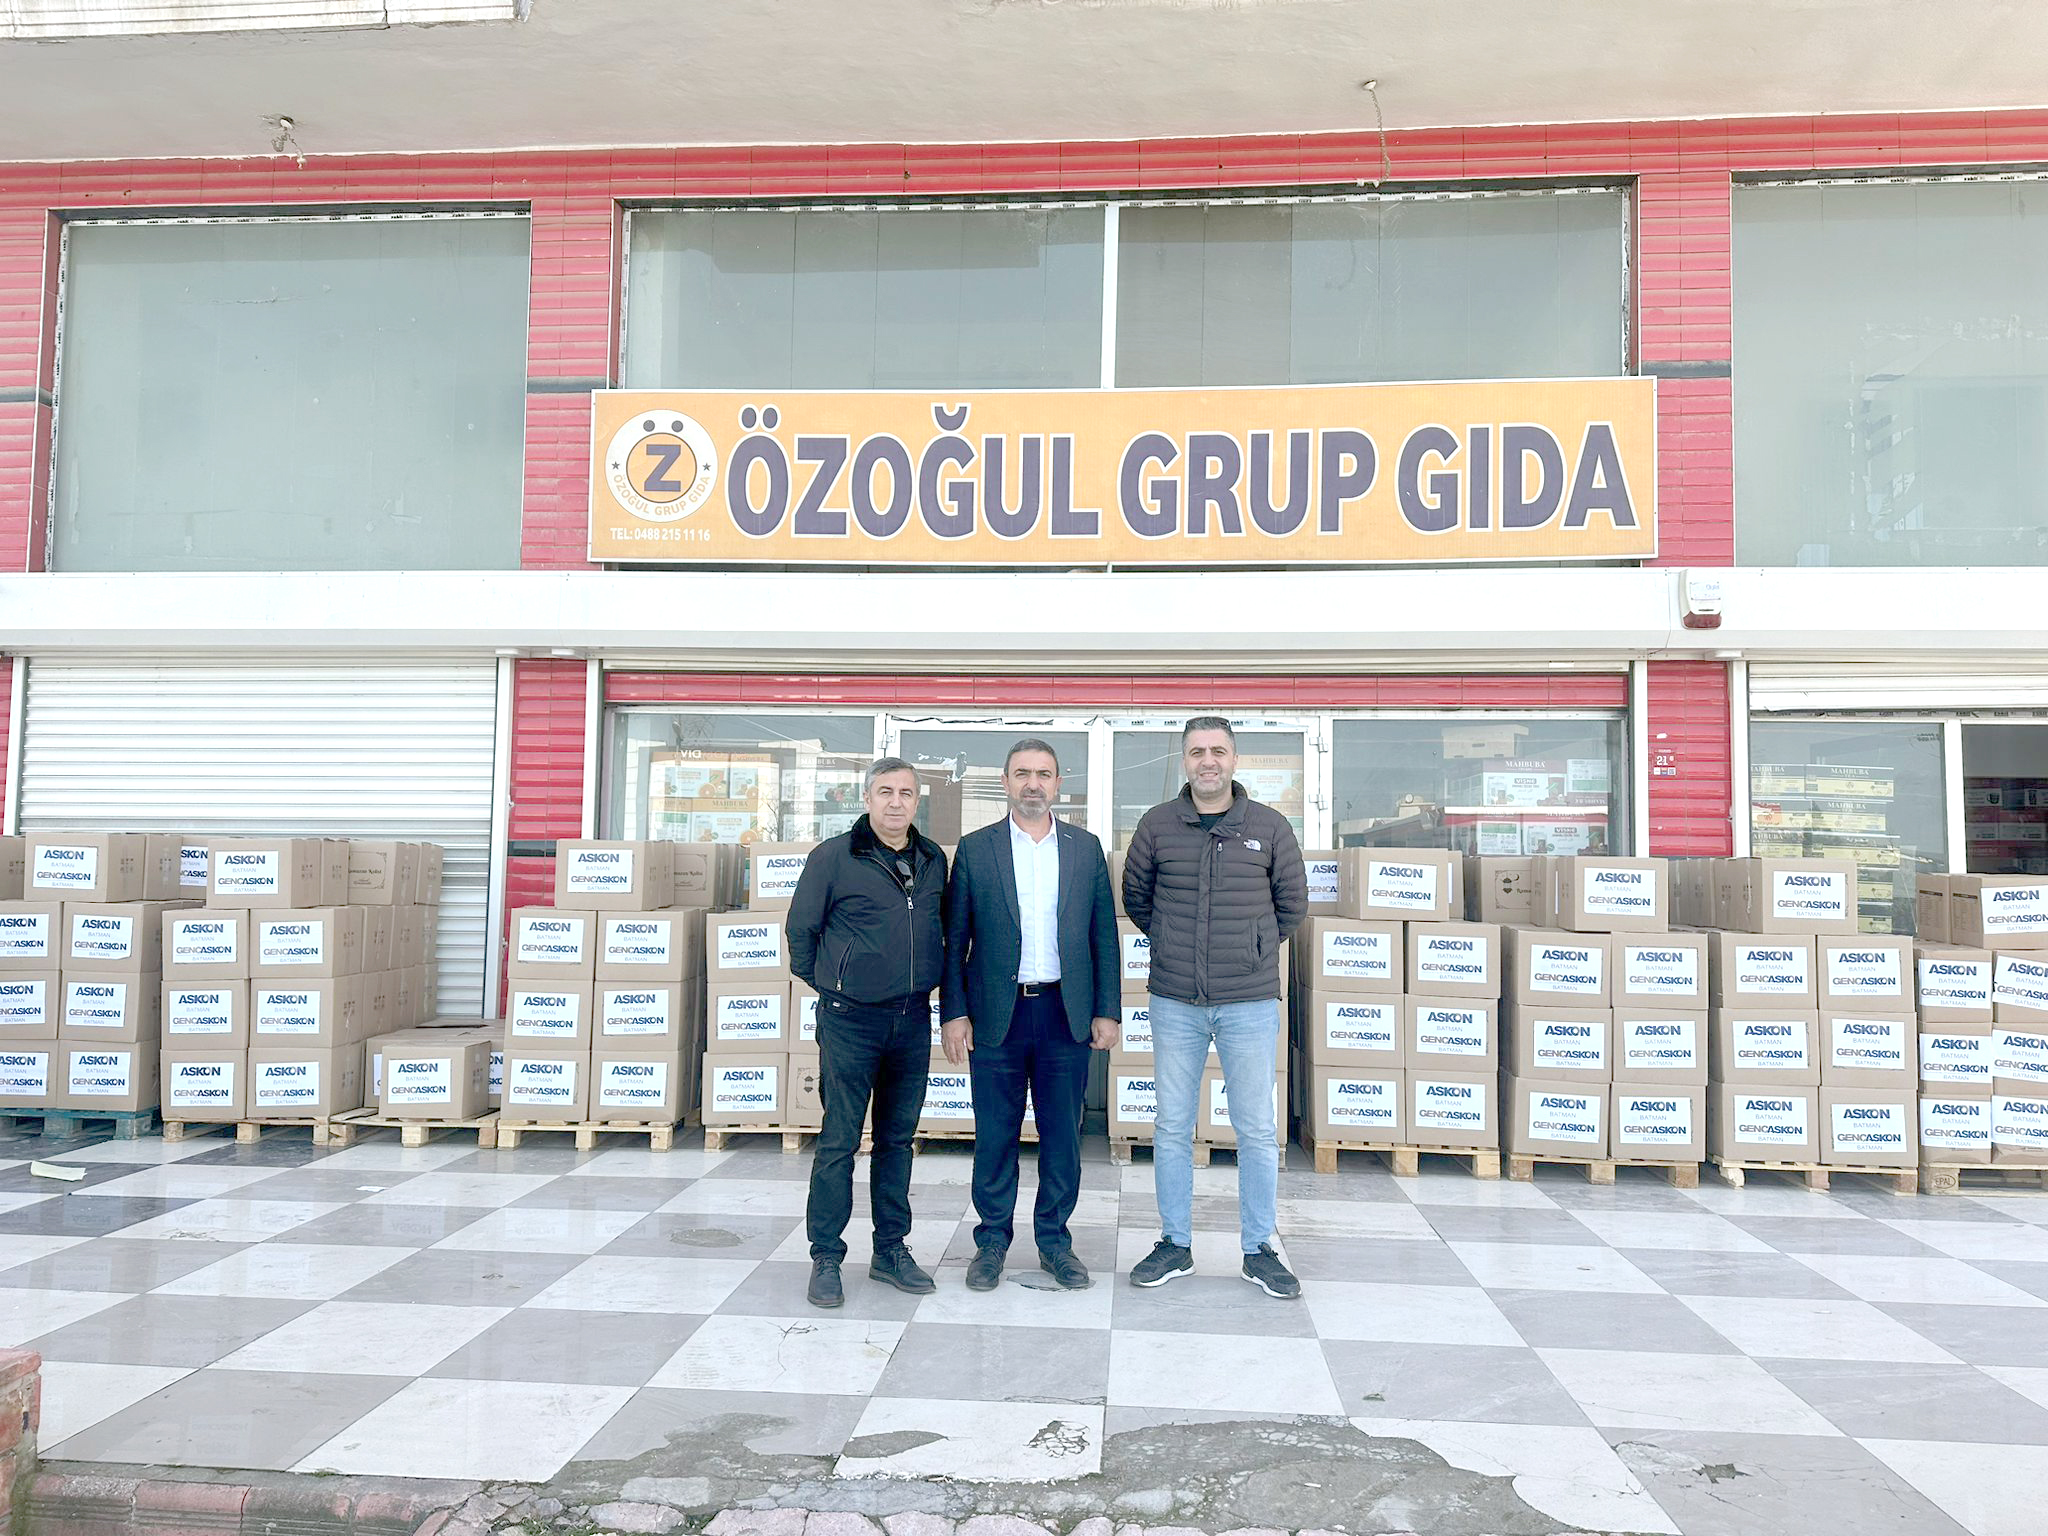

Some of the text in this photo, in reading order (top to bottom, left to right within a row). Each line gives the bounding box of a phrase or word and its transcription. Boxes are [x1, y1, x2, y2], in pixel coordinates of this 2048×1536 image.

[727, 405, 1637, 539] ÖZOĞUL GRUP GIDA
[613, 473, 711, 516] ÖZOĞUL GRUP GIDA
[610, 527, 711, 542] TEL: 0488 215 11 16
[1505, 760, 1546, 768] MAHBUBA
[1830, 767, 1870, 776] MAHBUBA
[43, 850, 84, 860] ASKON
[181, 850, 208, 858] SKON
[578, 853, 619, 862] ASKON
[224, 855, 266, 864] ASKON
[766, 858, 806, 868] ASKON
[1312, 865, 1337, 873] ASK
[1379, 866, 1422, 878] ASKON
[1595, 872, 1641, 883] ASKON
[1784, 876, 1830, 886] ASKON
[1993, 890, 2040, 901] ASKON
[0, 918, 36, 927] ASKON
[81, 919, 120, 929] ASKON
[529, 922, 570, 932] ASKON
[182, 924, 223, 933] ASKON
[269, 925, 310, 935] ASKON
[615, 924, 657, 933] ASKON
[727, 928, 767, 938] ASKON
[1333, 936, 1377, 946] ASKON
[1428, 940, 1472, 950] ASKON
[1542, 950, 1588, 961] ASKON
[1636, 952, 1682, 962] ASKON
[1746, 950, 1792, 961] ASKON
[1838, 952, 1885, 962] ASKON
[1928, 964, 1976, 976] ASKON
[75, 986, 114, 996] ASKON
[178, 994, 218, 1004] ASKON
[266, 994, 307, 1004] ASKON
[523, 996, 566, 1006] ASKON
[613, 994, 655, 1004] ASKON
[727, 999, 768, 1009] ASKON
[1336, 1007, 1381, 1018] ASKON
[1427, 1012, 1472, 1023] ASKON
[1544, 1025, 1590, 1036] ASKON
[1634, 1025, 1681, 1035] ASKON
[1744, 1025, 1791, 1036] ASKON
[1843, 1024, 1890, 1035] ASKON
[1930, 1038, 1978, 1050] ASKON
[2003, 1036, 2048, 1049] ASKON
[0, 1056, 36, 1066] ASKON
[78, 1056, 118, 1065] ASKON
[180, 1066, 220, 1076] ASKON
[265, 1066, 306, 1076] ASKON
[397, 1063, 438, 1073] ASKON
[520, 1063, 562, 1074] ASKON
[611, 1065, 653, 1076] ASKON
[722, 1070, 764, 1080] ASKON
[1127, 1081, 1156, 1090] ASK
[1338, 1083, 1382, 1094] ASKON
[1426, 1086, 1471, 1097] ASKON
[1540, 1097, 1586, 1109] ASKON
[1630, 1101, 1676, 1111] ASKON
[1745, 1100, 1792, 1111] ASKON
[2003, 1102, 2048, 1114] ASKON
[1843, 1108, 1890, 1119] ASKON
[1931, 1104, 1979, 1115] ASKON
